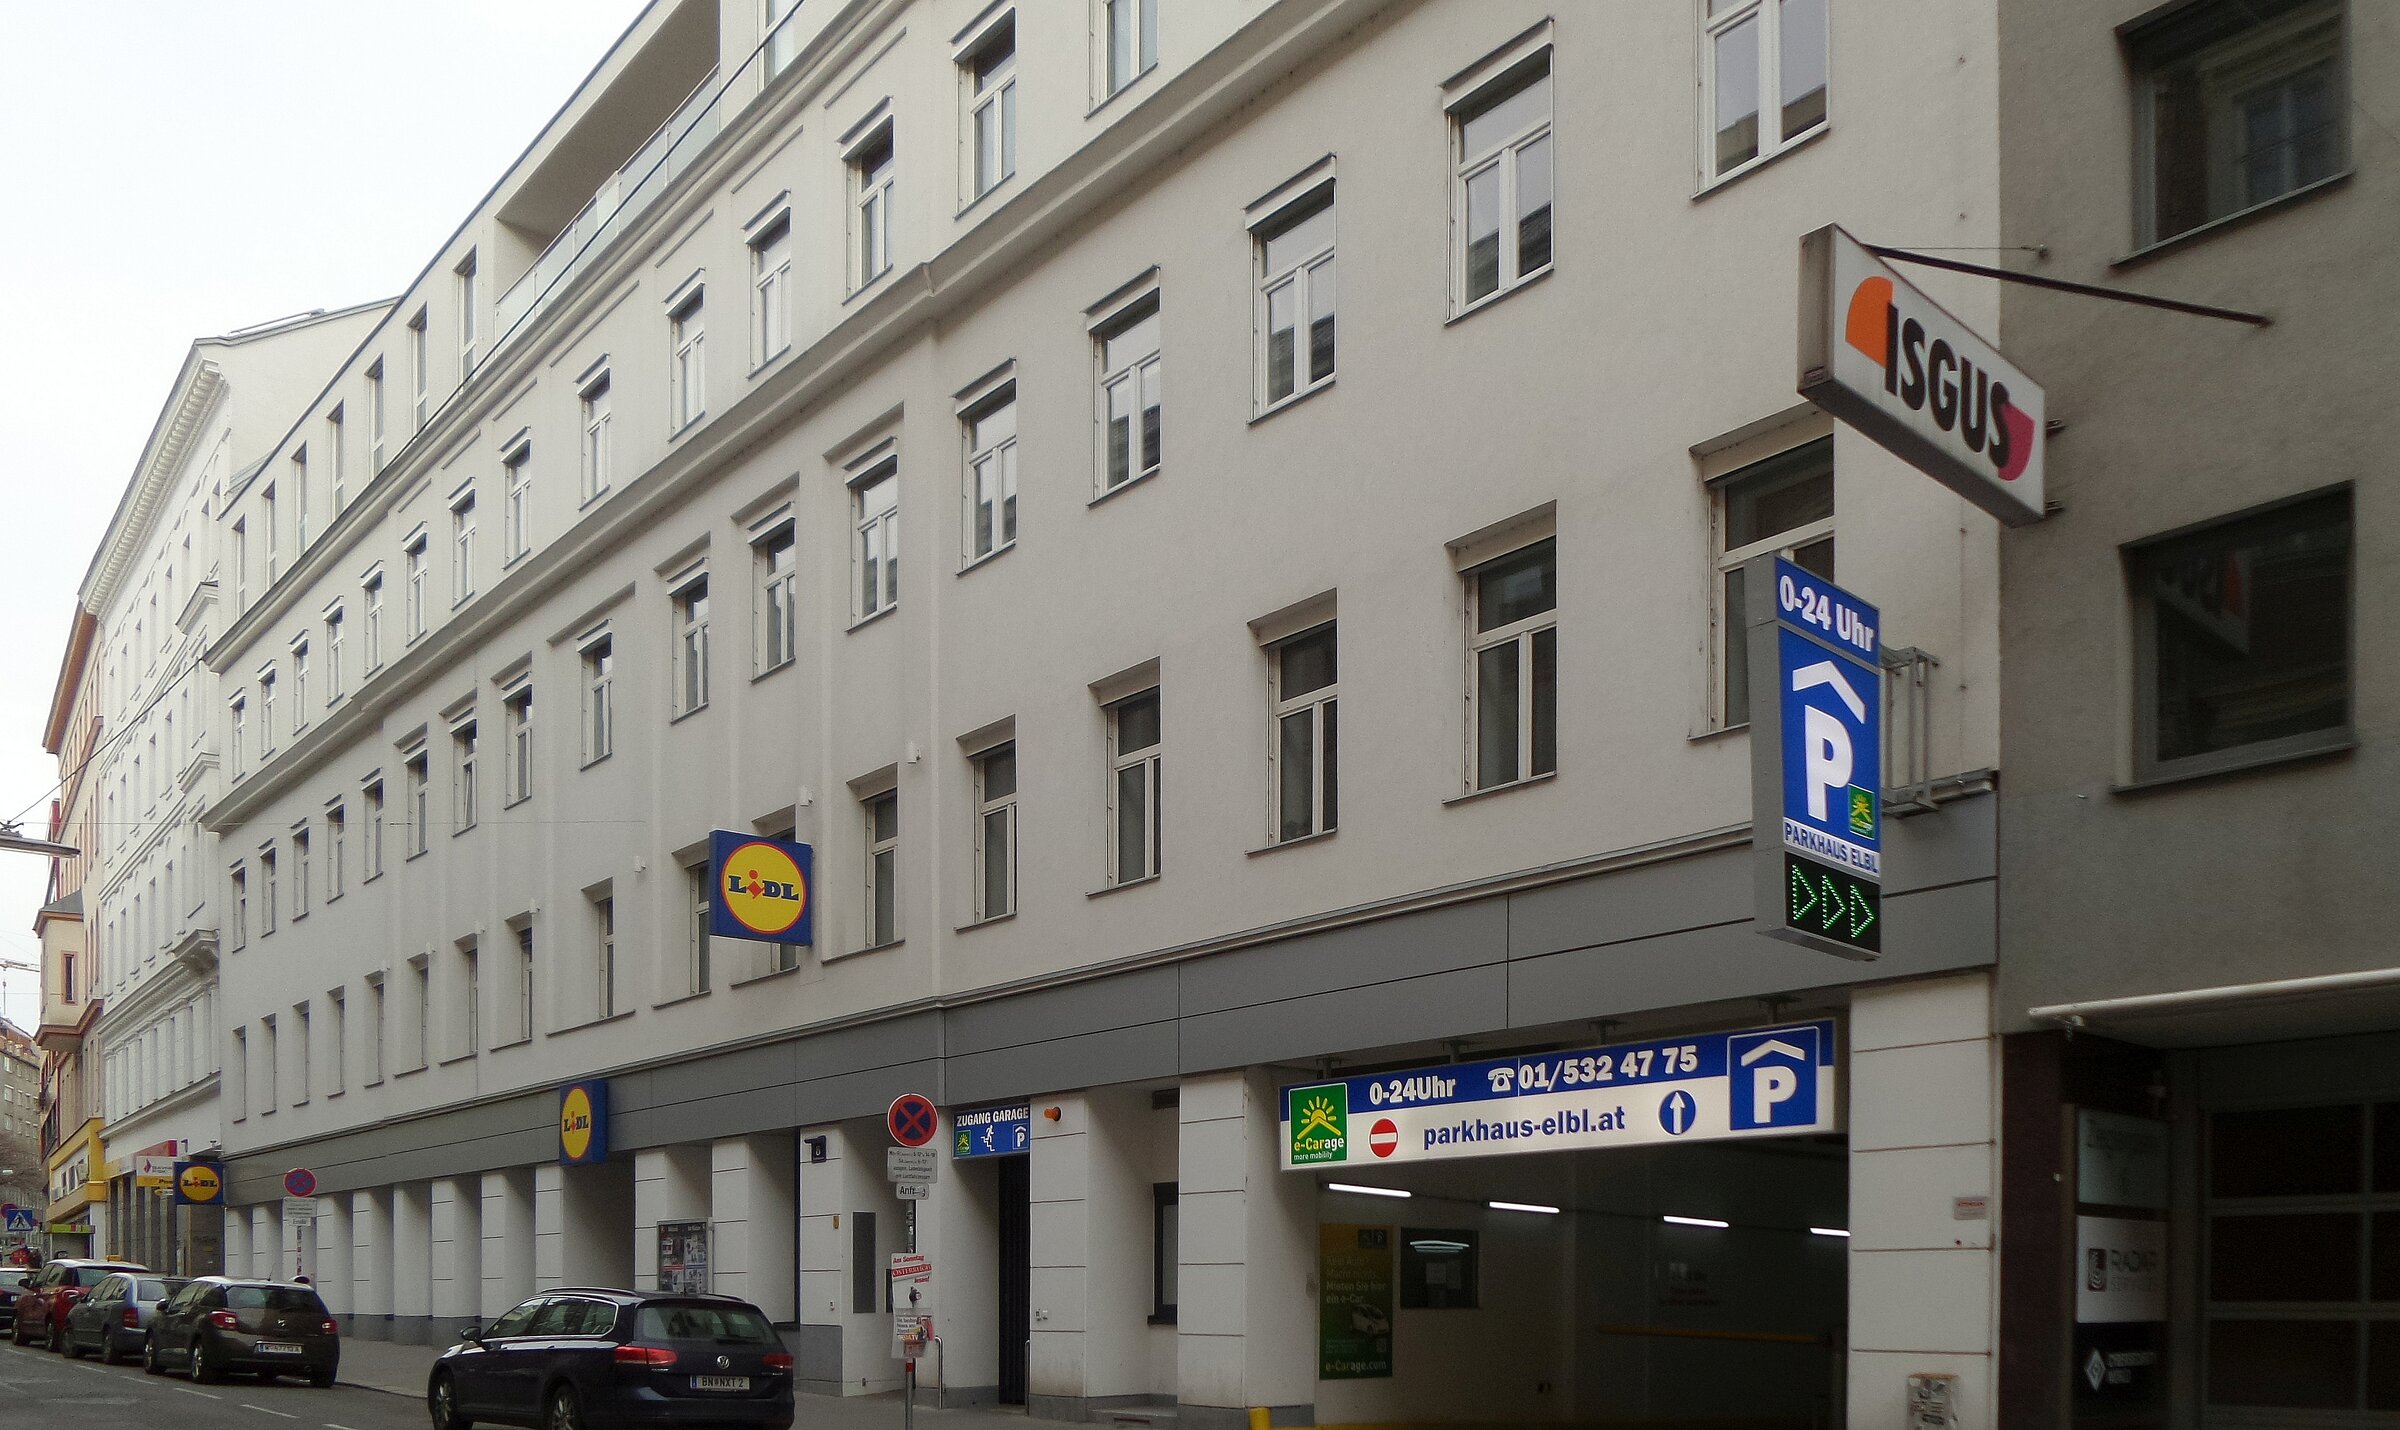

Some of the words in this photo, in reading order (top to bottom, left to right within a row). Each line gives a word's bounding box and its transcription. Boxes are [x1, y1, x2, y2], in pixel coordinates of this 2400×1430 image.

[1885, 302, 2011, 469] ISGUS
[1780, 575, 1831, 630] 0-24
[1836, 603, 1874, 651] Uhr
[1804, 704, 1853, 822] P
[1785, 822, 1848, 862] PARKHAUS
[1851, 848, 1878, 873] ELBL
[1369, 1076, 1457, 1106] 0-24Uhr
[1519, 1055, 1613, 1092] 01/532
[1620, 1050, 1654, 1078] 47
[1662, 1045, 1698, 1074] 75
[1752, 1065, 1798, 1124] P
[957, 1111, 990, 1127] ZUGANG
[993, 1107, 1029, 1122] GARAGE
[1423, 1105, 1626, 1151] parkhaus-elbl.at
[1293, 1137, 1344, 1151] e-Carage
[1310, 1151, 1332, 1160] mobility
[900, 1186, 926, 1197] Anfg
[701, 1377, 714, 1387] BN
[719, 1378, 736, 1388] NXT
[738, 1379, 744, 1388] 2
[1325, 1360, 1387, 1373] e-Carage.com
